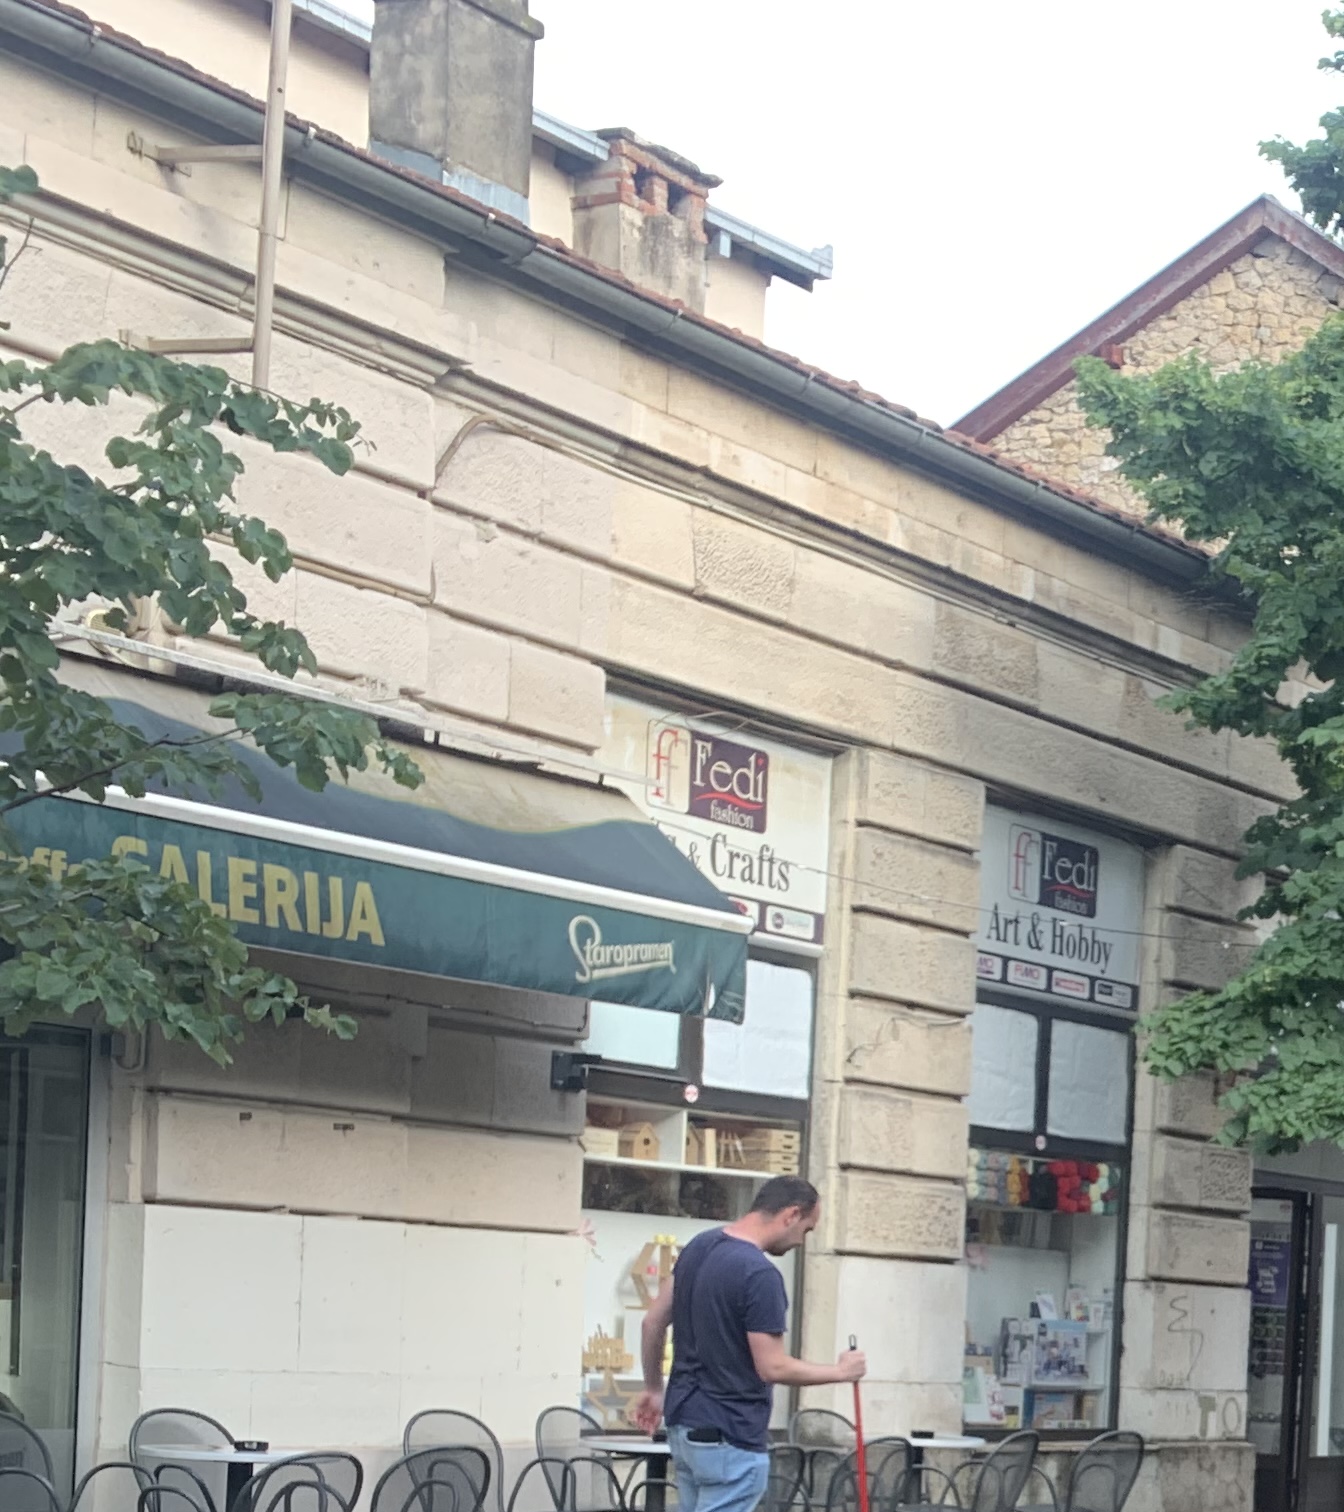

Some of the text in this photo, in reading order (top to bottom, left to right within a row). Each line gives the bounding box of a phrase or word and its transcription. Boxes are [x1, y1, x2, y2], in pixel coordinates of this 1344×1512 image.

[693, 739, 765, 803] Fedi
[710, 802, 754, 829] fashion
[709, 832, 790, 892] Crafts
[1042, 840, 1096, 892] Fedi
[568, 914, 677, 984] Staropramen
[986, 902, 1113, 975] Art & Hobby
